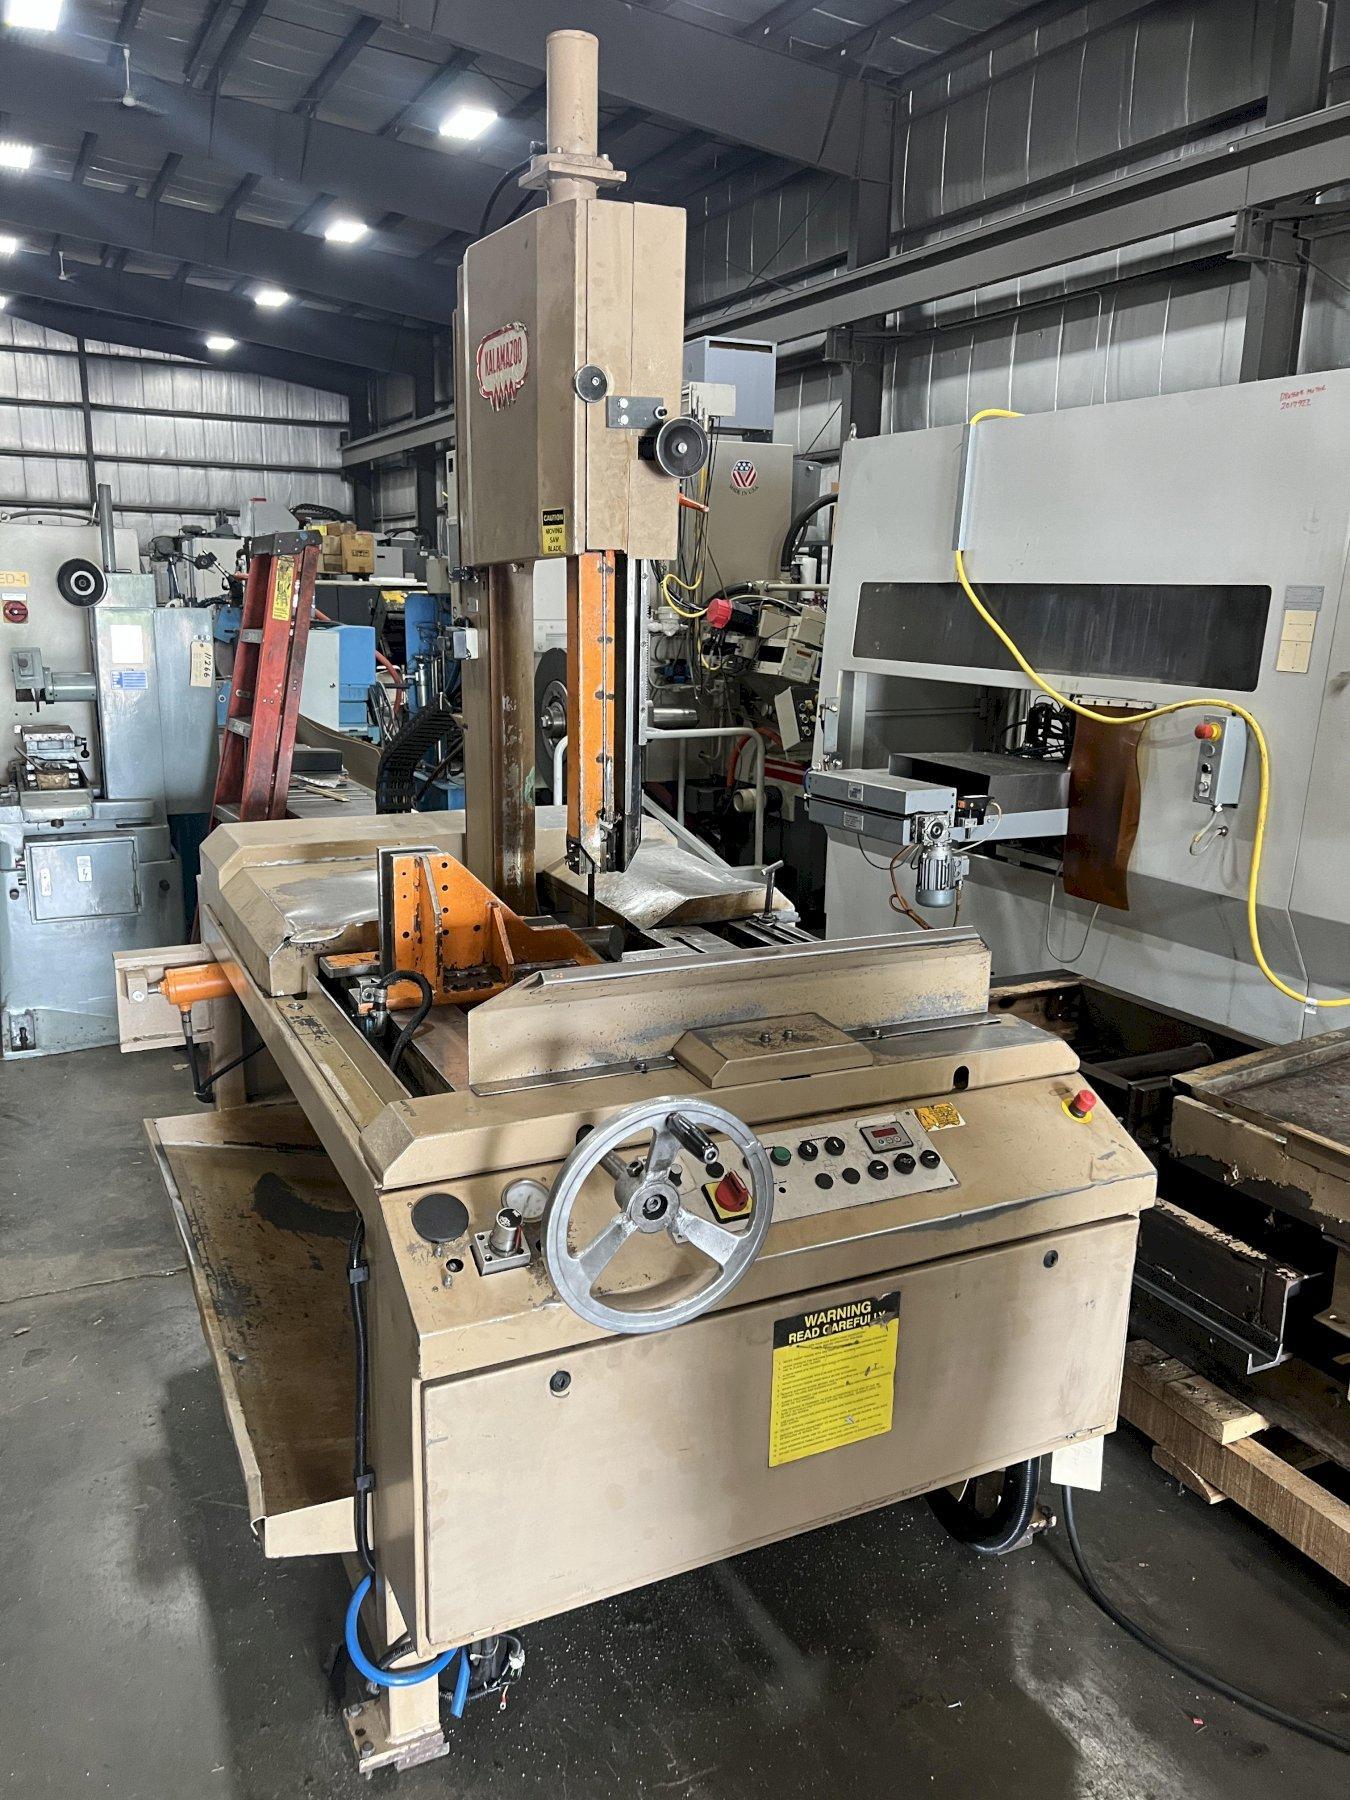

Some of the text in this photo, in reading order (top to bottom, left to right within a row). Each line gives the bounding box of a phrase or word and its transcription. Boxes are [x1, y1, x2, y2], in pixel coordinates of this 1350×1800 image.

[484, 336, 523, 376] KALAMAZOO
[804, 1301, 872, 1328] WARNING
[788, 1327, 820, 1344] READ
